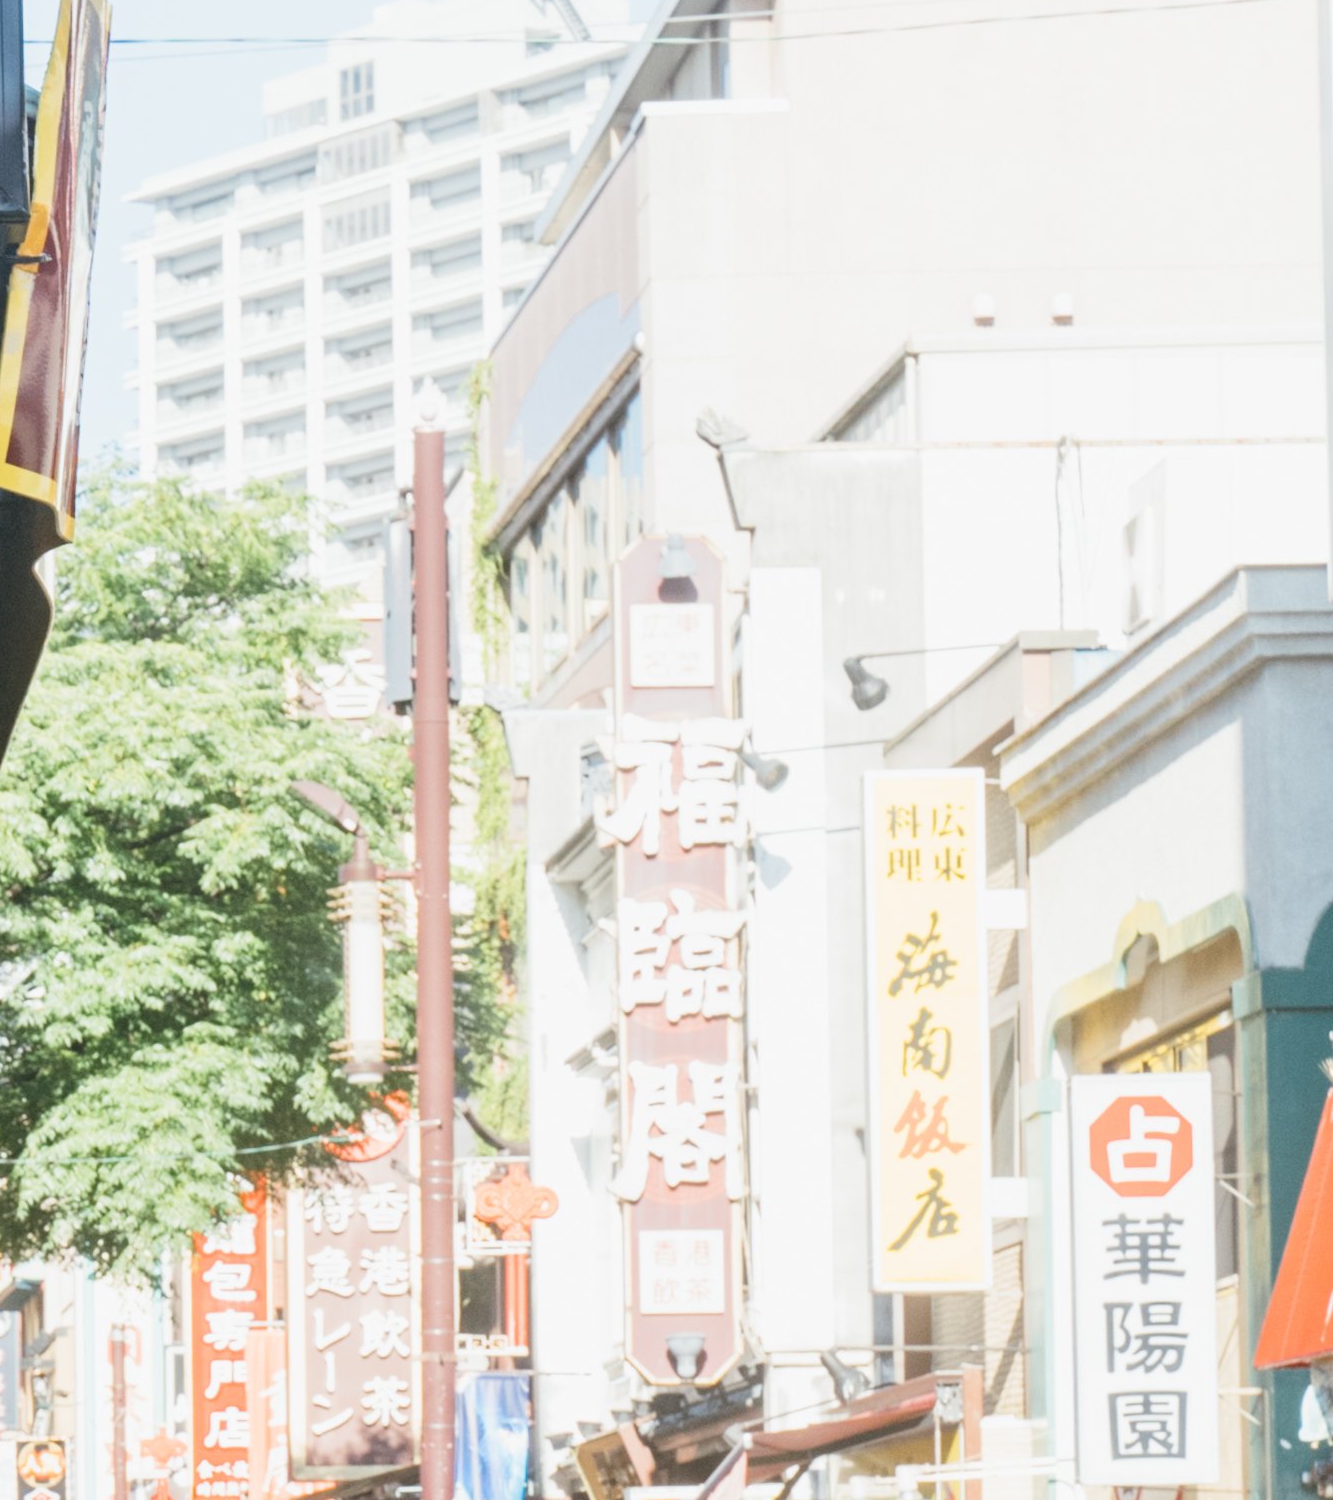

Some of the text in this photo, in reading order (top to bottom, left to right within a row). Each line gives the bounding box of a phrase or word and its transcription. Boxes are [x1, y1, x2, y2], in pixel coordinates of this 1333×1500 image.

[888, 910, 973, 1253] 海南飯店
[1107, 1103, 1182, 1183] 占
[1102, 1210, 1191, 1462] 華陽園
